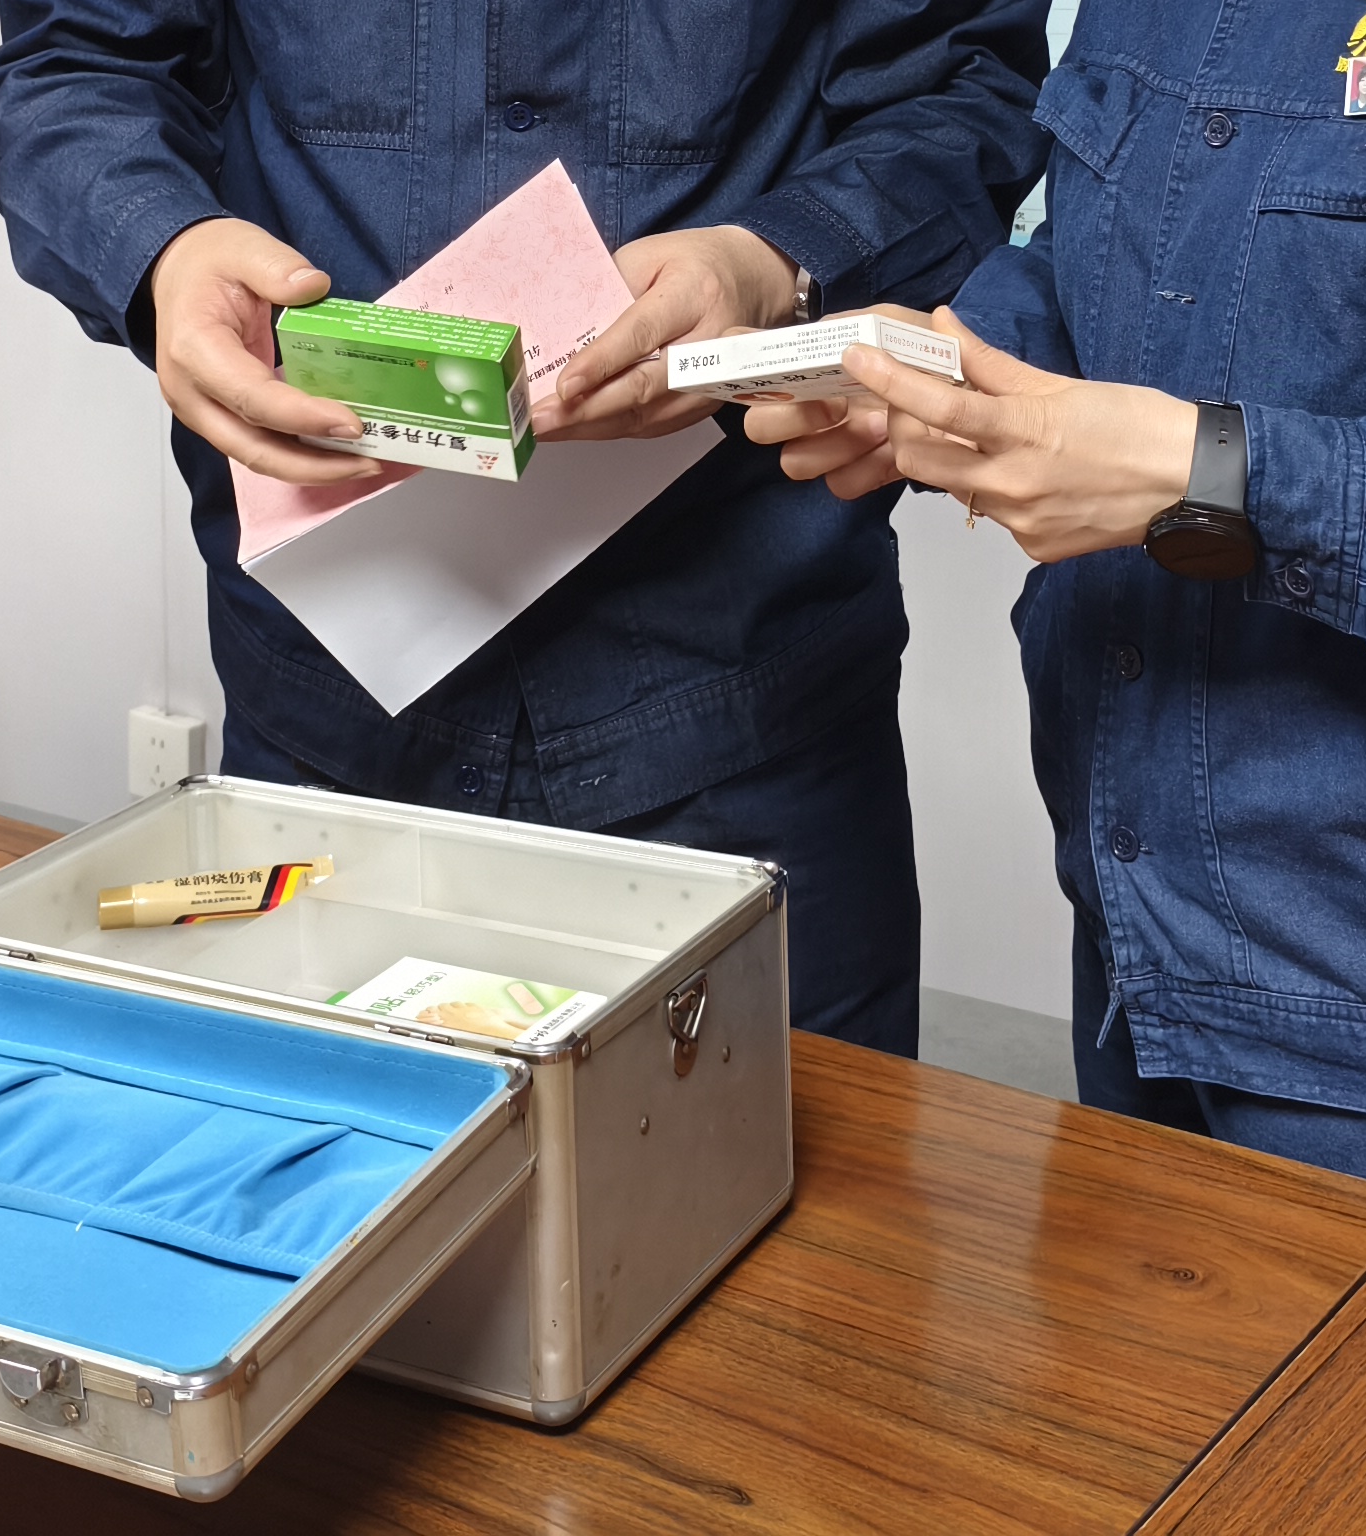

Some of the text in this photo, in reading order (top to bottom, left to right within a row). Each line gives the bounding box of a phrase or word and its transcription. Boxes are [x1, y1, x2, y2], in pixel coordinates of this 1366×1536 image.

[678, 354, 722, 372] 120丸装
[174, 870, 263, 887] 湿润烧伤膏
